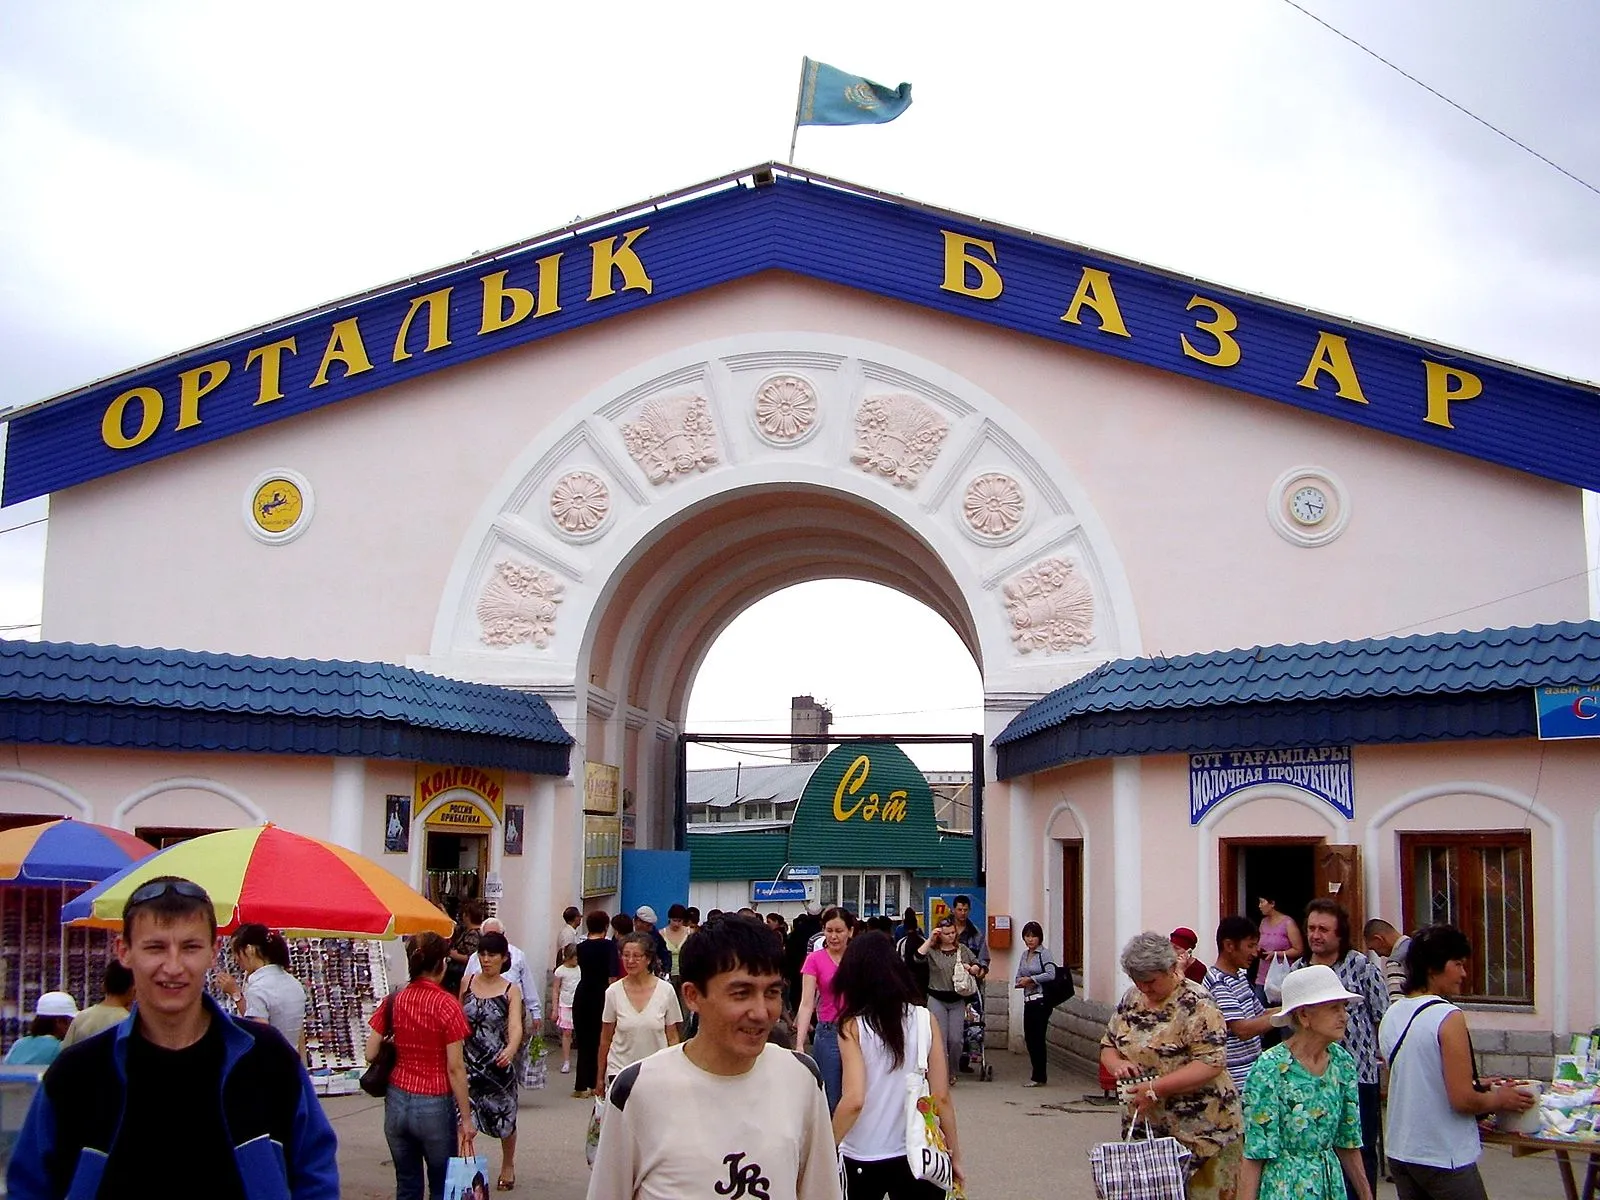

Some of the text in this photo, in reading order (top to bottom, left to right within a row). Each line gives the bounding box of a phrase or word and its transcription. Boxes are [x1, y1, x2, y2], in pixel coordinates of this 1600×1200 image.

[101, 226, 1483, 450] ОРТАЛЫҚ БАЗАР
[1230, 747, 1350, 766] ТАҒАМДАРЫ
[420, 765, 500, 803] КОЛГОТКИ
[1192, 763, 1352, 815] МОЛОЧНАЯ ПРОДУКЦИЯ
